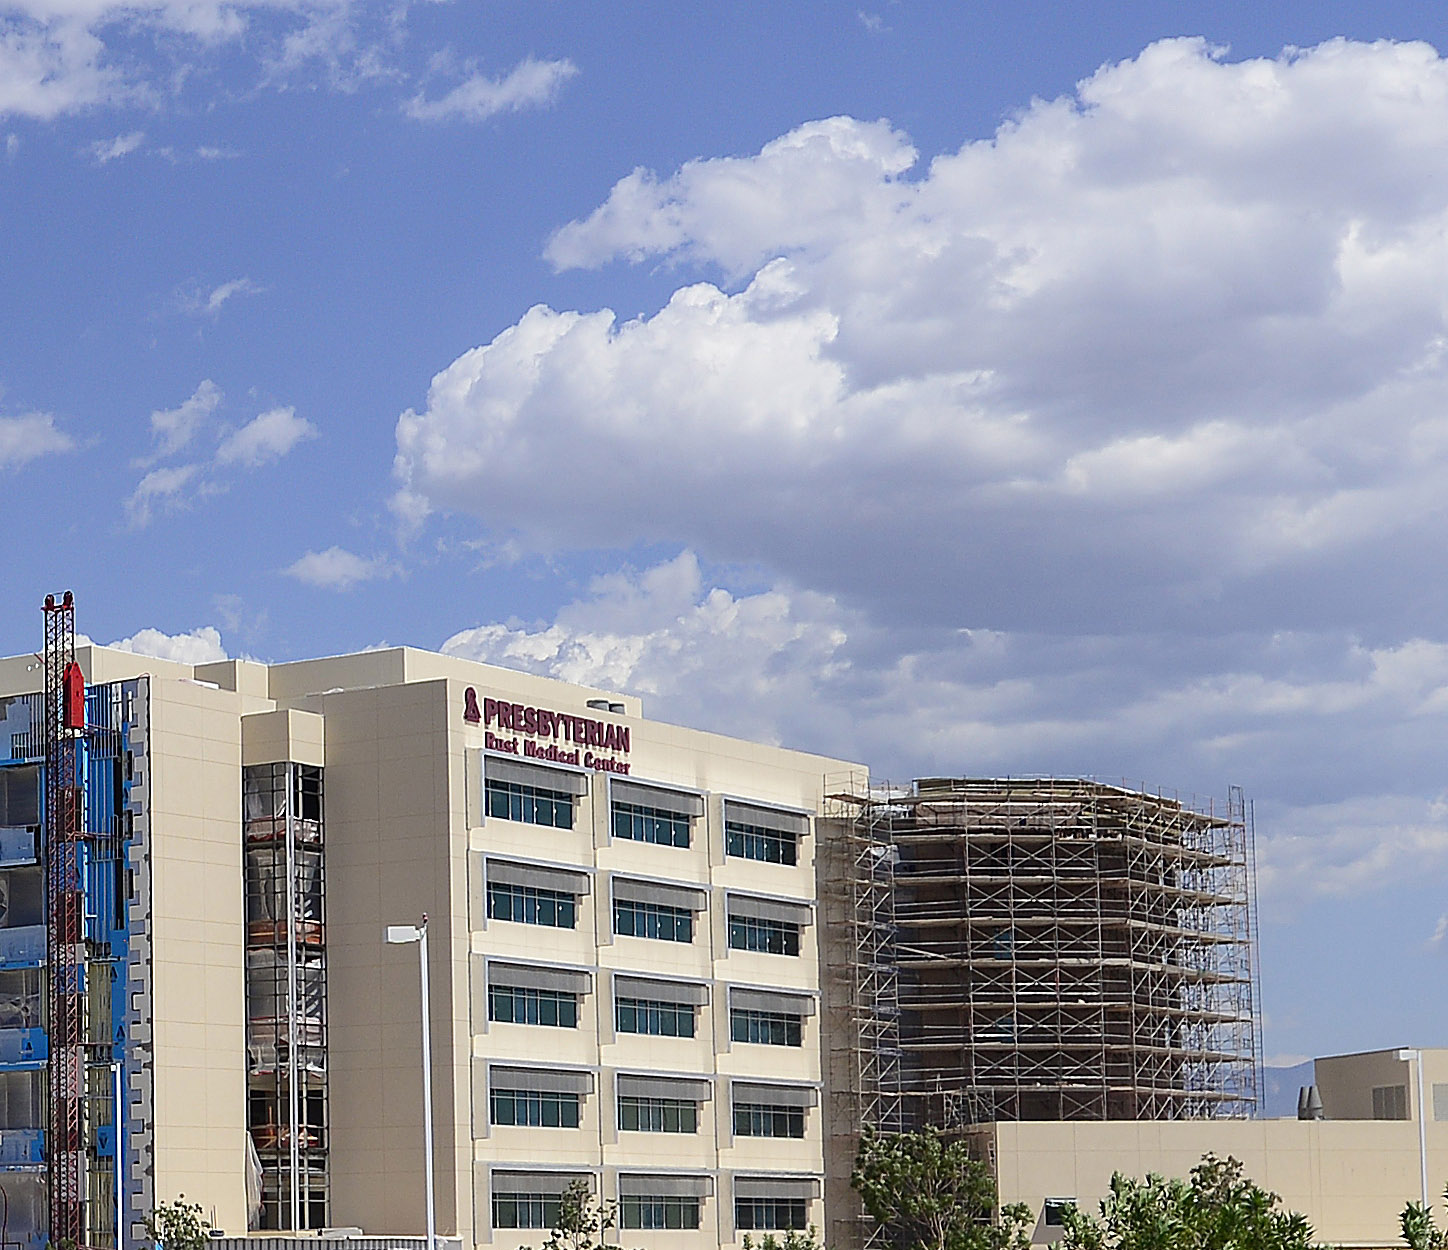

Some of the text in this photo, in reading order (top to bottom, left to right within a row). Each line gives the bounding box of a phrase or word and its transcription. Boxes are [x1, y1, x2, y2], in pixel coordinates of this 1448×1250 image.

[484, 697, 630, 753] PRESBYTERIAN
[485, 731, 631, 775] Rust Medical Center
